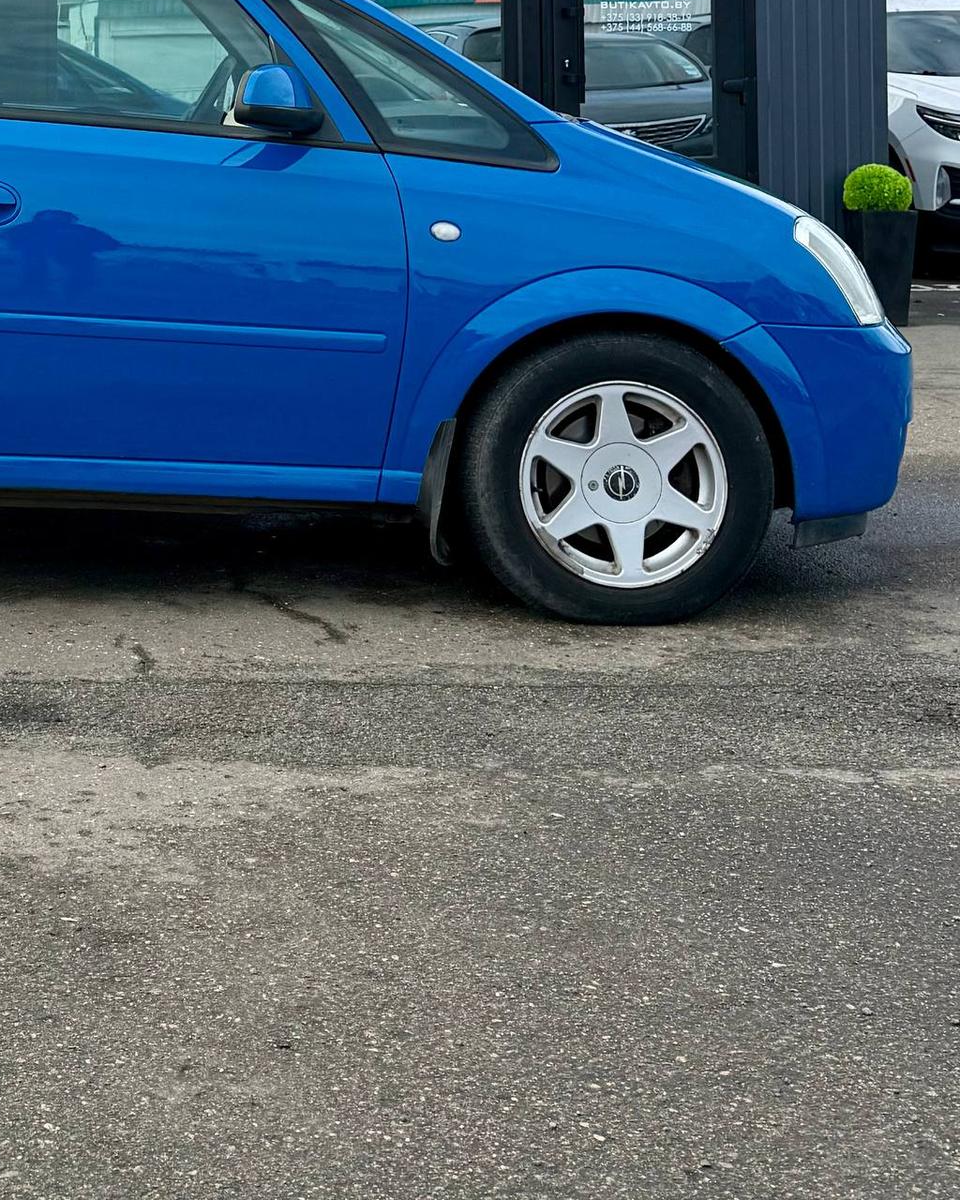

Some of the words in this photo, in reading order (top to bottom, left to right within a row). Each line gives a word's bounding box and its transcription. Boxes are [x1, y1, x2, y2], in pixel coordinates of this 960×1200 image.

[600, 1, 691, 9] BUTIKAVTO.BY
[601, 13, 624, 22] +375
[626, 12, 644, 23] (33)
[601, 23, 623, 32] +375
[626, 22, 644, 33] (44)
